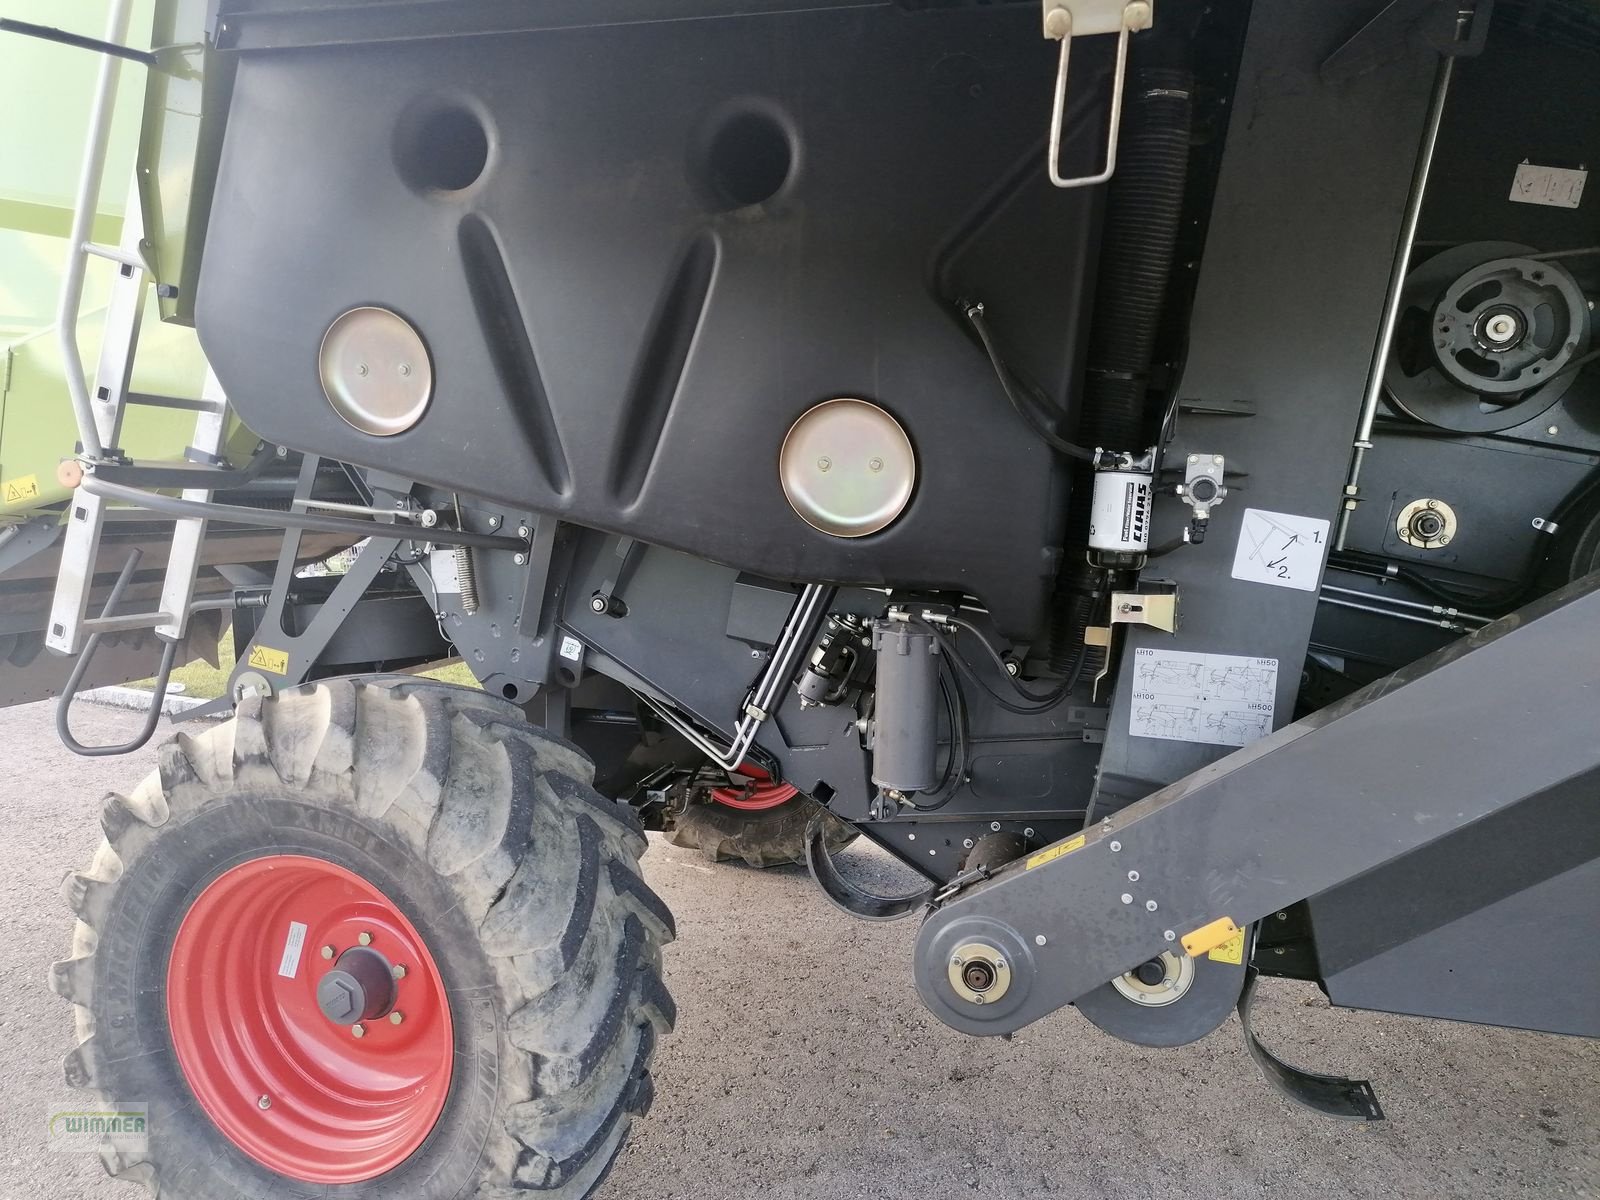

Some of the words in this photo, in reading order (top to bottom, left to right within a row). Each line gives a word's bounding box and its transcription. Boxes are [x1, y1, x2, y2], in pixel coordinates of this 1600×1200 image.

[1133, 483, 1146, 542] CLAAS
[1313, 530, 1323, 543] 1.
[1277, 565, 1291, 579] 2.
